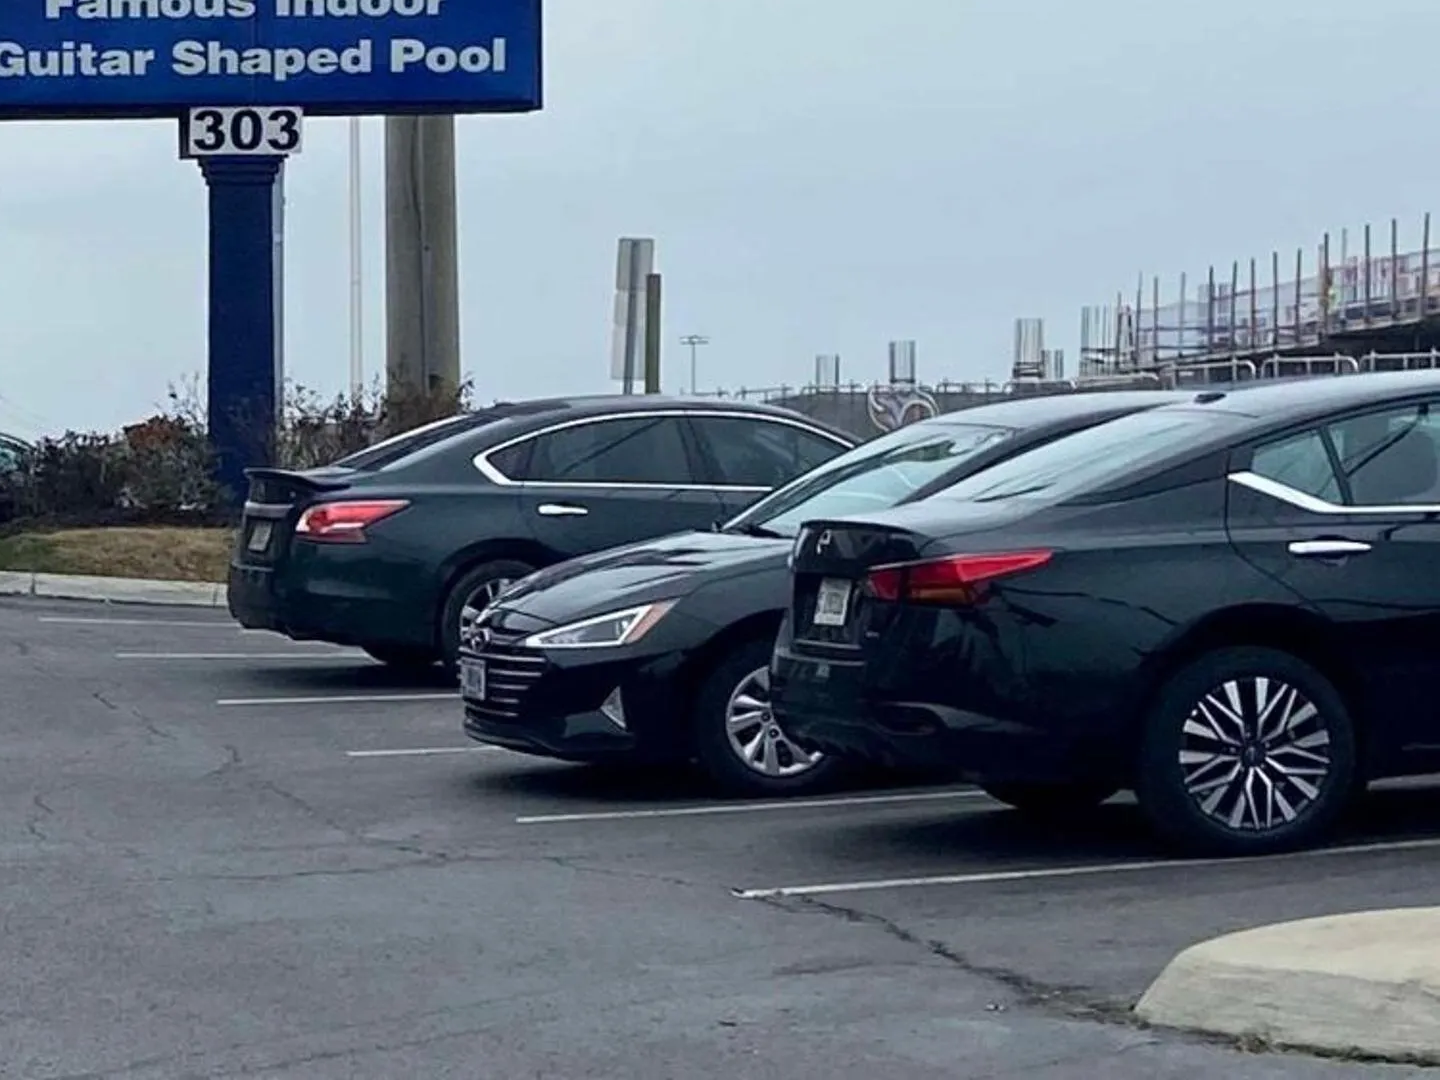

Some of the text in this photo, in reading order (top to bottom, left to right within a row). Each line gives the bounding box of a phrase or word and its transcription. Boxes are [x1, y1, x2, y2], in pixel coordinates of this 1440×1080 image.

[171, 39, 372, 81] Shaped
[390, 37, 506, 73] Pool
[193, 109, 300, 151] 303
